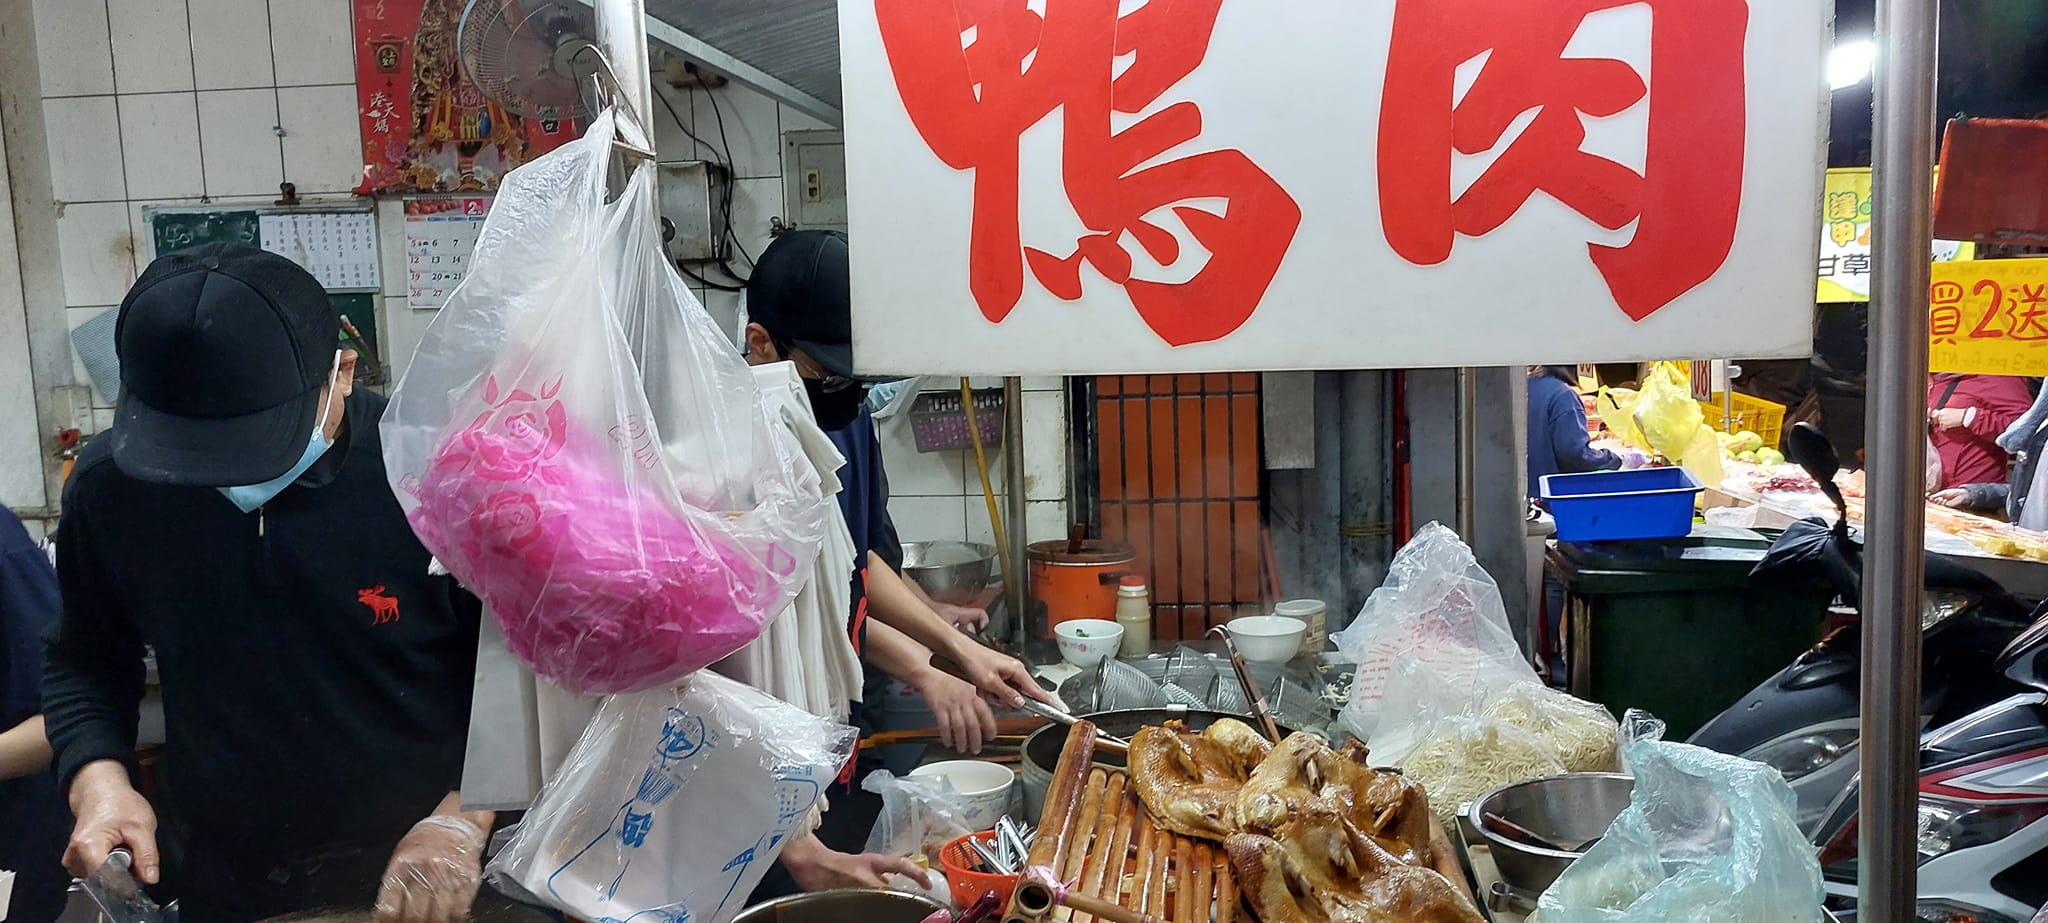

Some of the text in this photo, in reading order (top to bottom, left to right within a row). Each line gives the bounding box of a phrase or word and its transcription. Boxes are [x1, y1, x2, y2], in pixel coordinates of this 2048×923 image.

[876, 0, 1749, 346] 鴨肉
[453, 239, 459, 248] 7
[410, 255, 461, 264] 12 13 14
